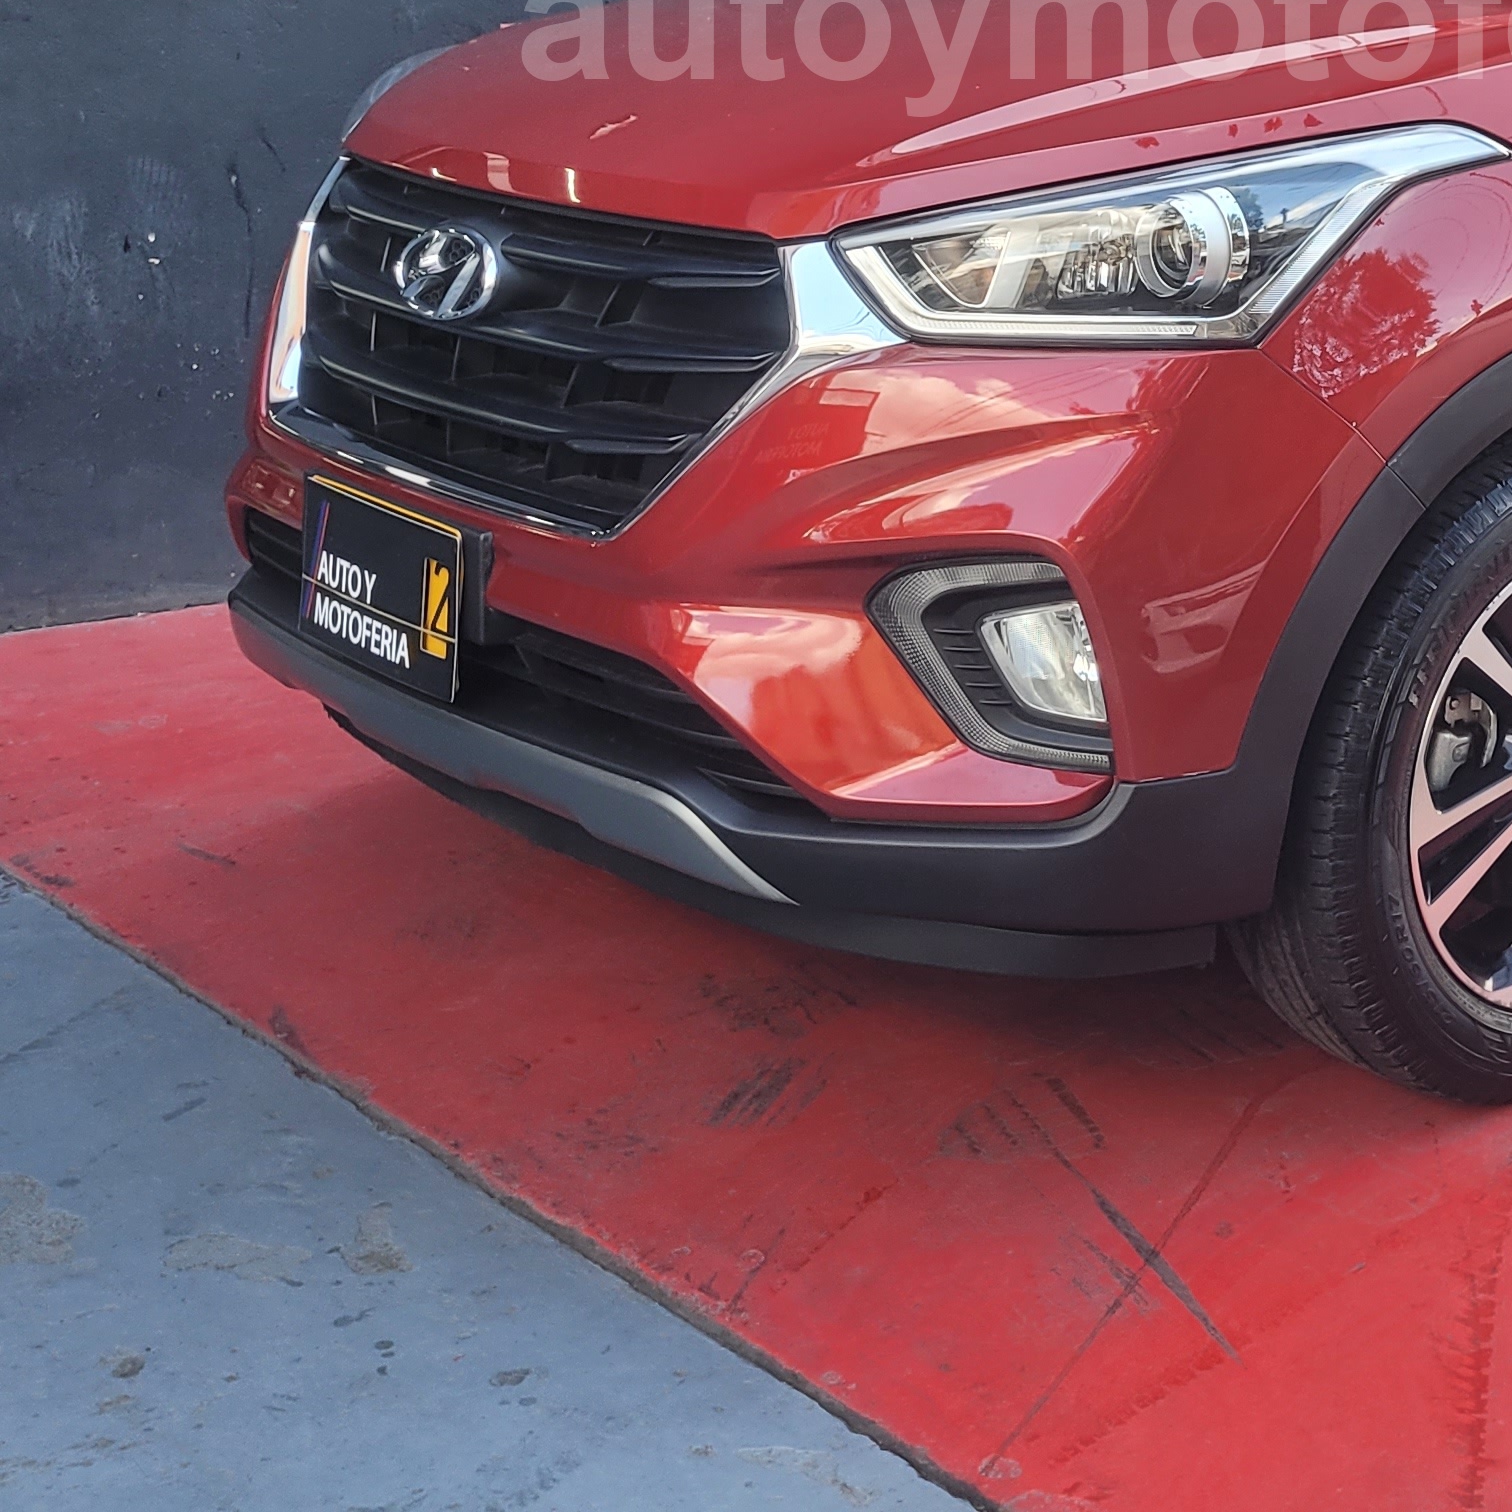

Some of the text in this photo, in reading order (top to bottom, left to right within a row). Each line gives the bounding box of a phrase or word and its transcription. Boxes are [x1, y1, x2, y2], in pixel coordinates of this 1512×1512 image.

[317, 550, 377, 605] AUTO Y
[313, 592, 411, 669] MOTOFERIA
